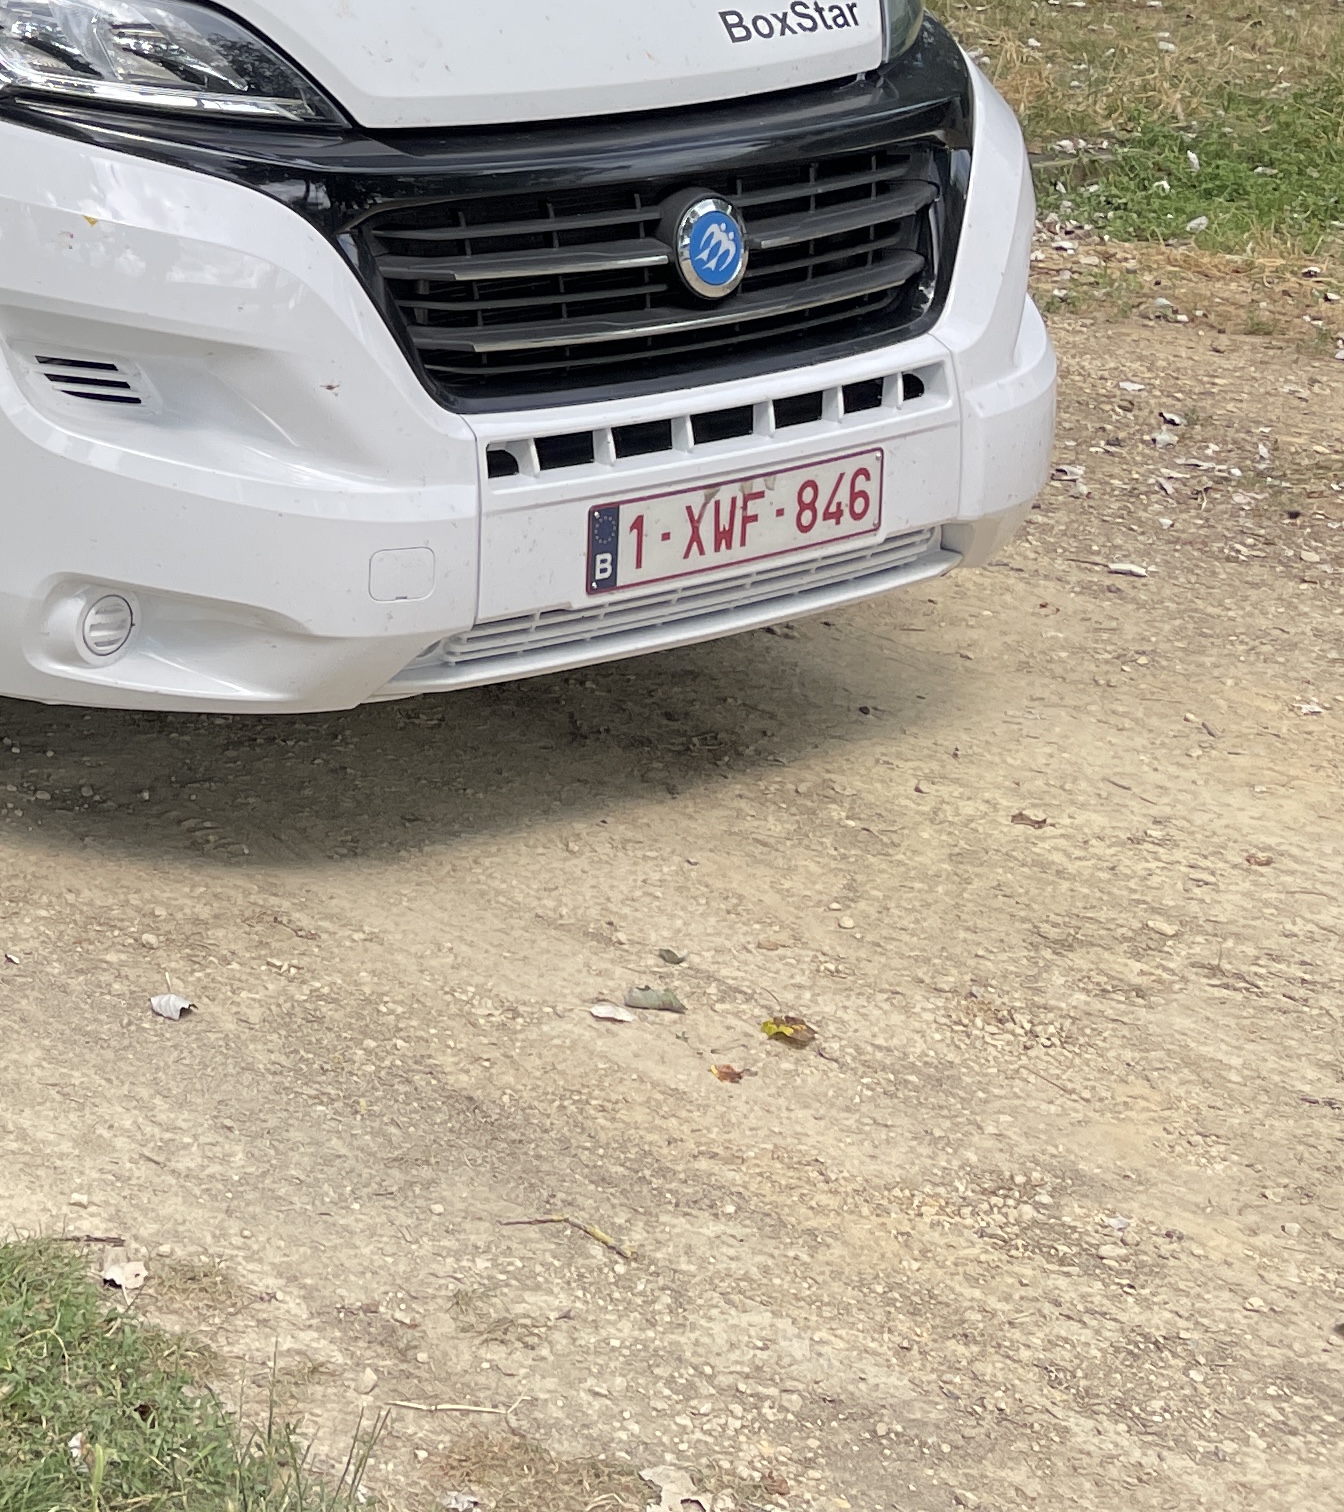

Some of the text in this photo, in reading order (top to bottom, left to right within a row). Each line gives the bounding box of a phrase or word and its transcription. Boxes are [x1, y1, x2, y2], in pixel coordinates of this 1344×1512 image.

[717, 0, 860, 44] BoxStar
[628, 467, 872, 570] 1-XWF-846
[594, 552, 613, 580] B
